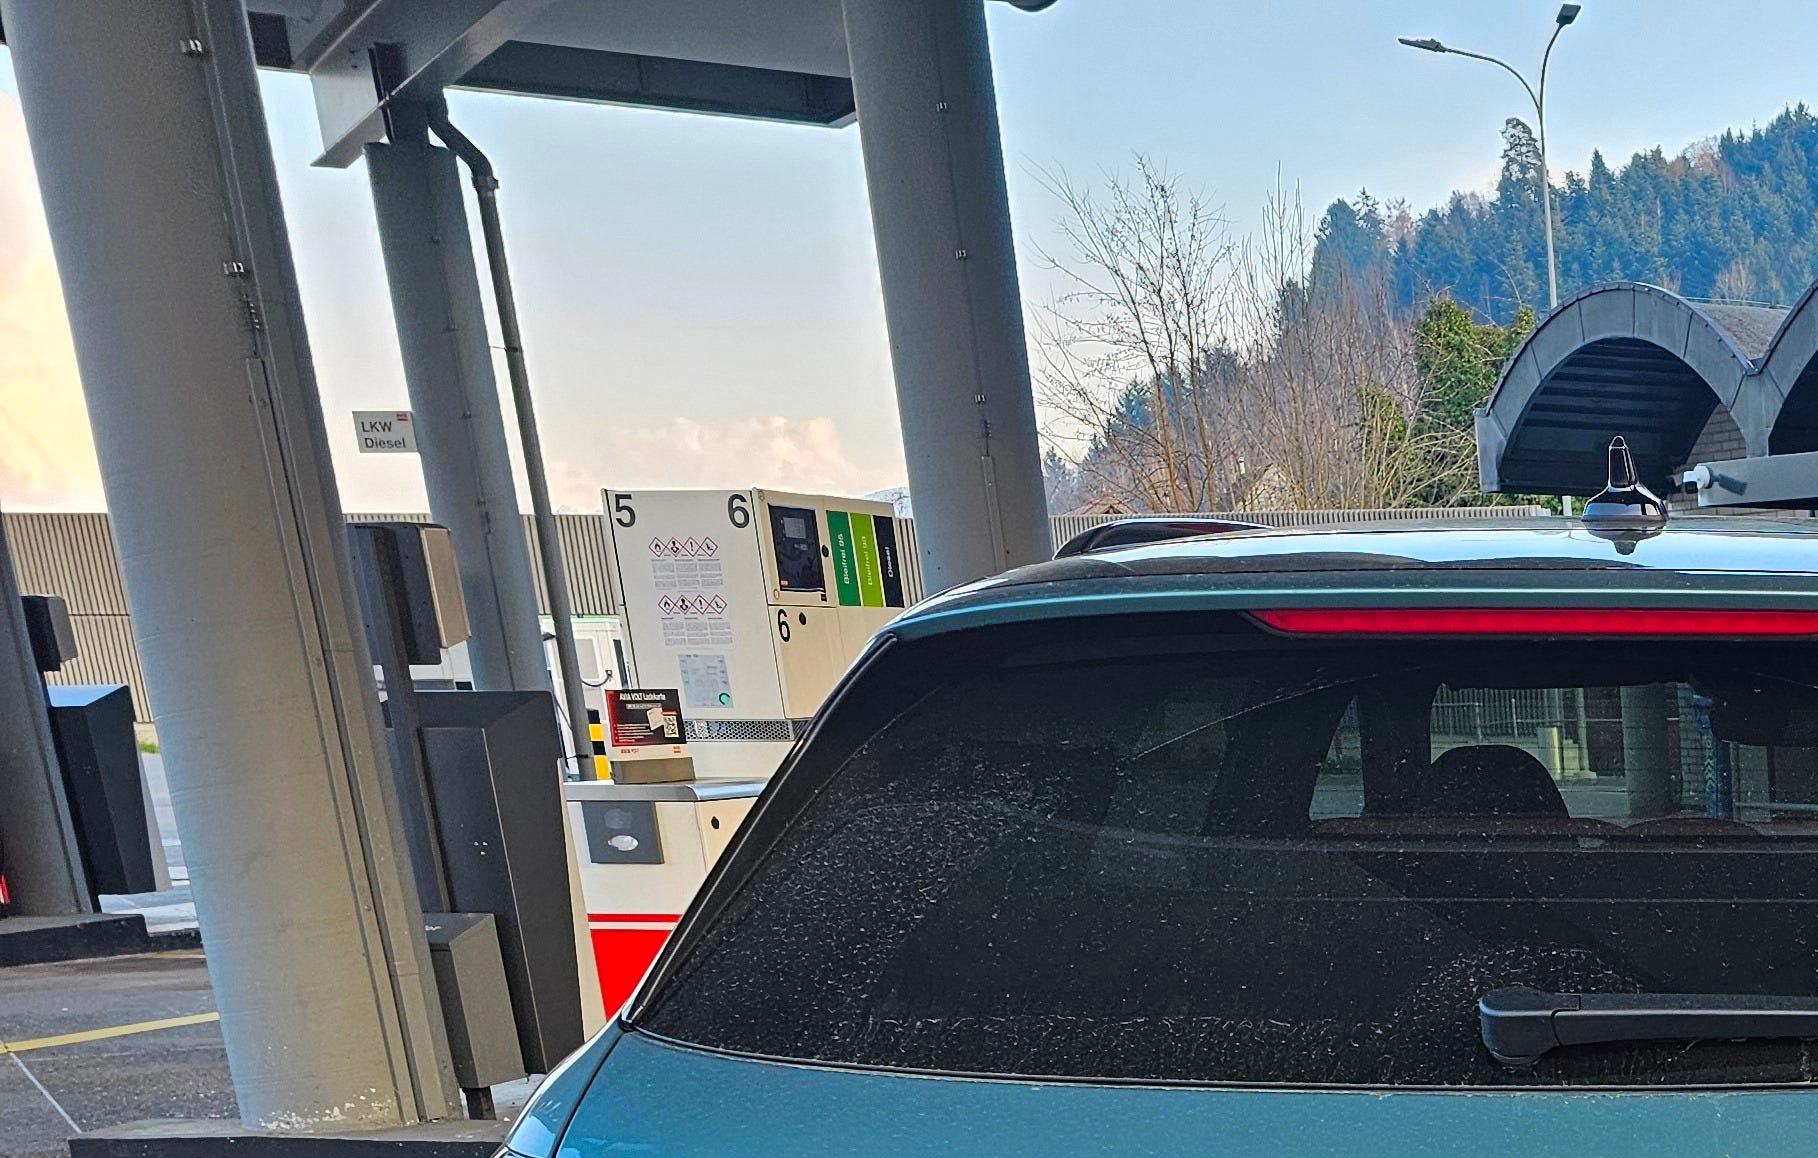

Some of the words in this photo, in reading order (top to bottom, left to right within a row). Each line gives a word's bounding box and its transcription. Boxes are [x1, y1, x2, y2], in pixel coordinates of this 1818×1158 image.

[360, 421, 393, 433] LKW
[364, 437, 406, 449] Diesel
[614, 493, 636, 528] 5
[727, 493, 750, 529] 6
[777, 608, 791, 643] 6
